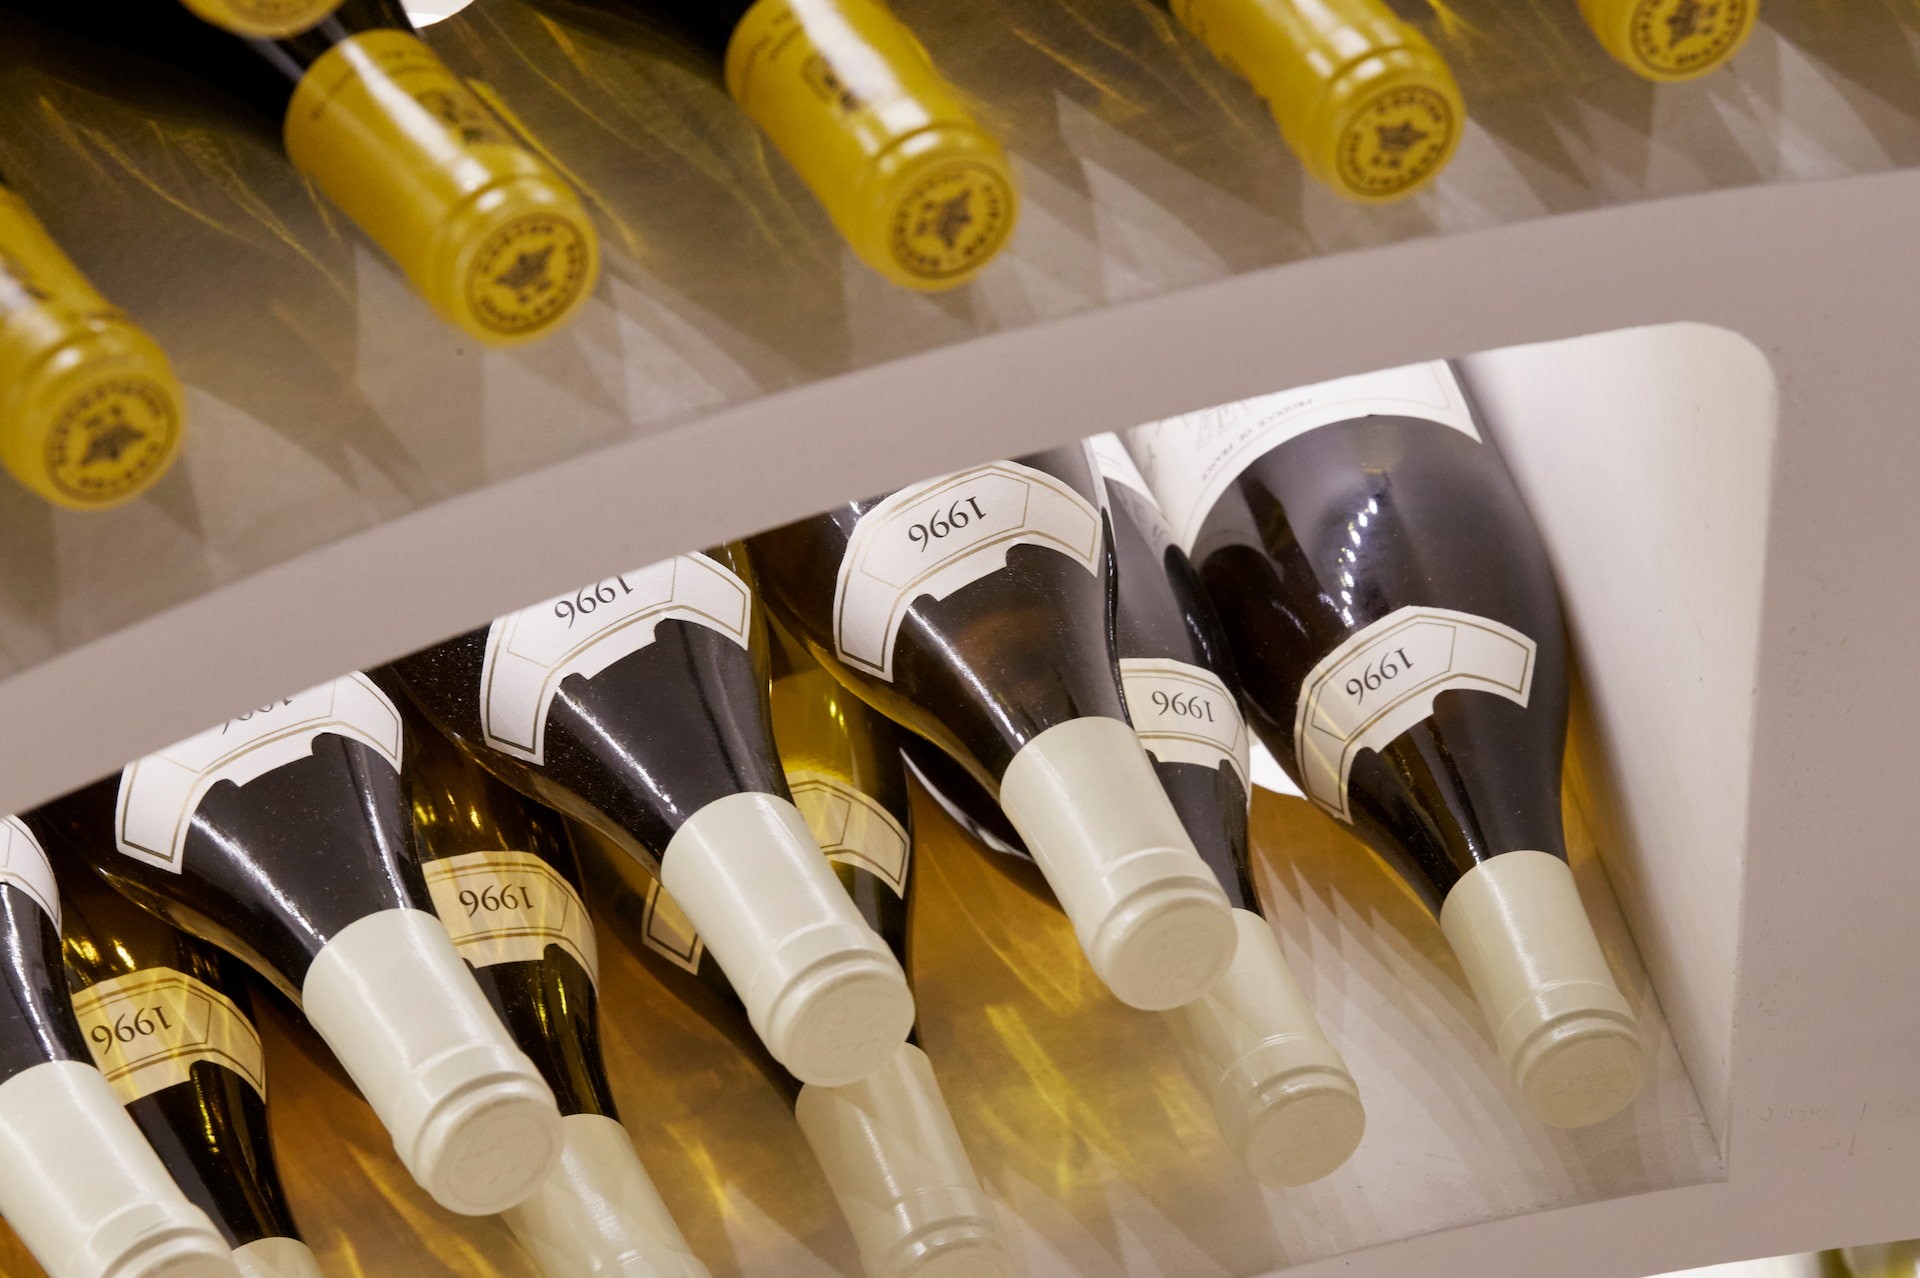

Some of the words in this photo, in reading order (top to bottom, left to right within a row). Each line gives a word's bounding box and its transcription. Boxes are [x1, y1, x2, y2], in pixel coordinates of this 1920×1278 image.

[908, 496, 987, 553] 1996
[554, 575, 634, 630] 1996
[1346, 646, 1415, 706] 1996
[1151, 690, 1215, 723] 1996
[458, 883, 534, 918] 1996
[91, 1006, 172, 1055] 1996
